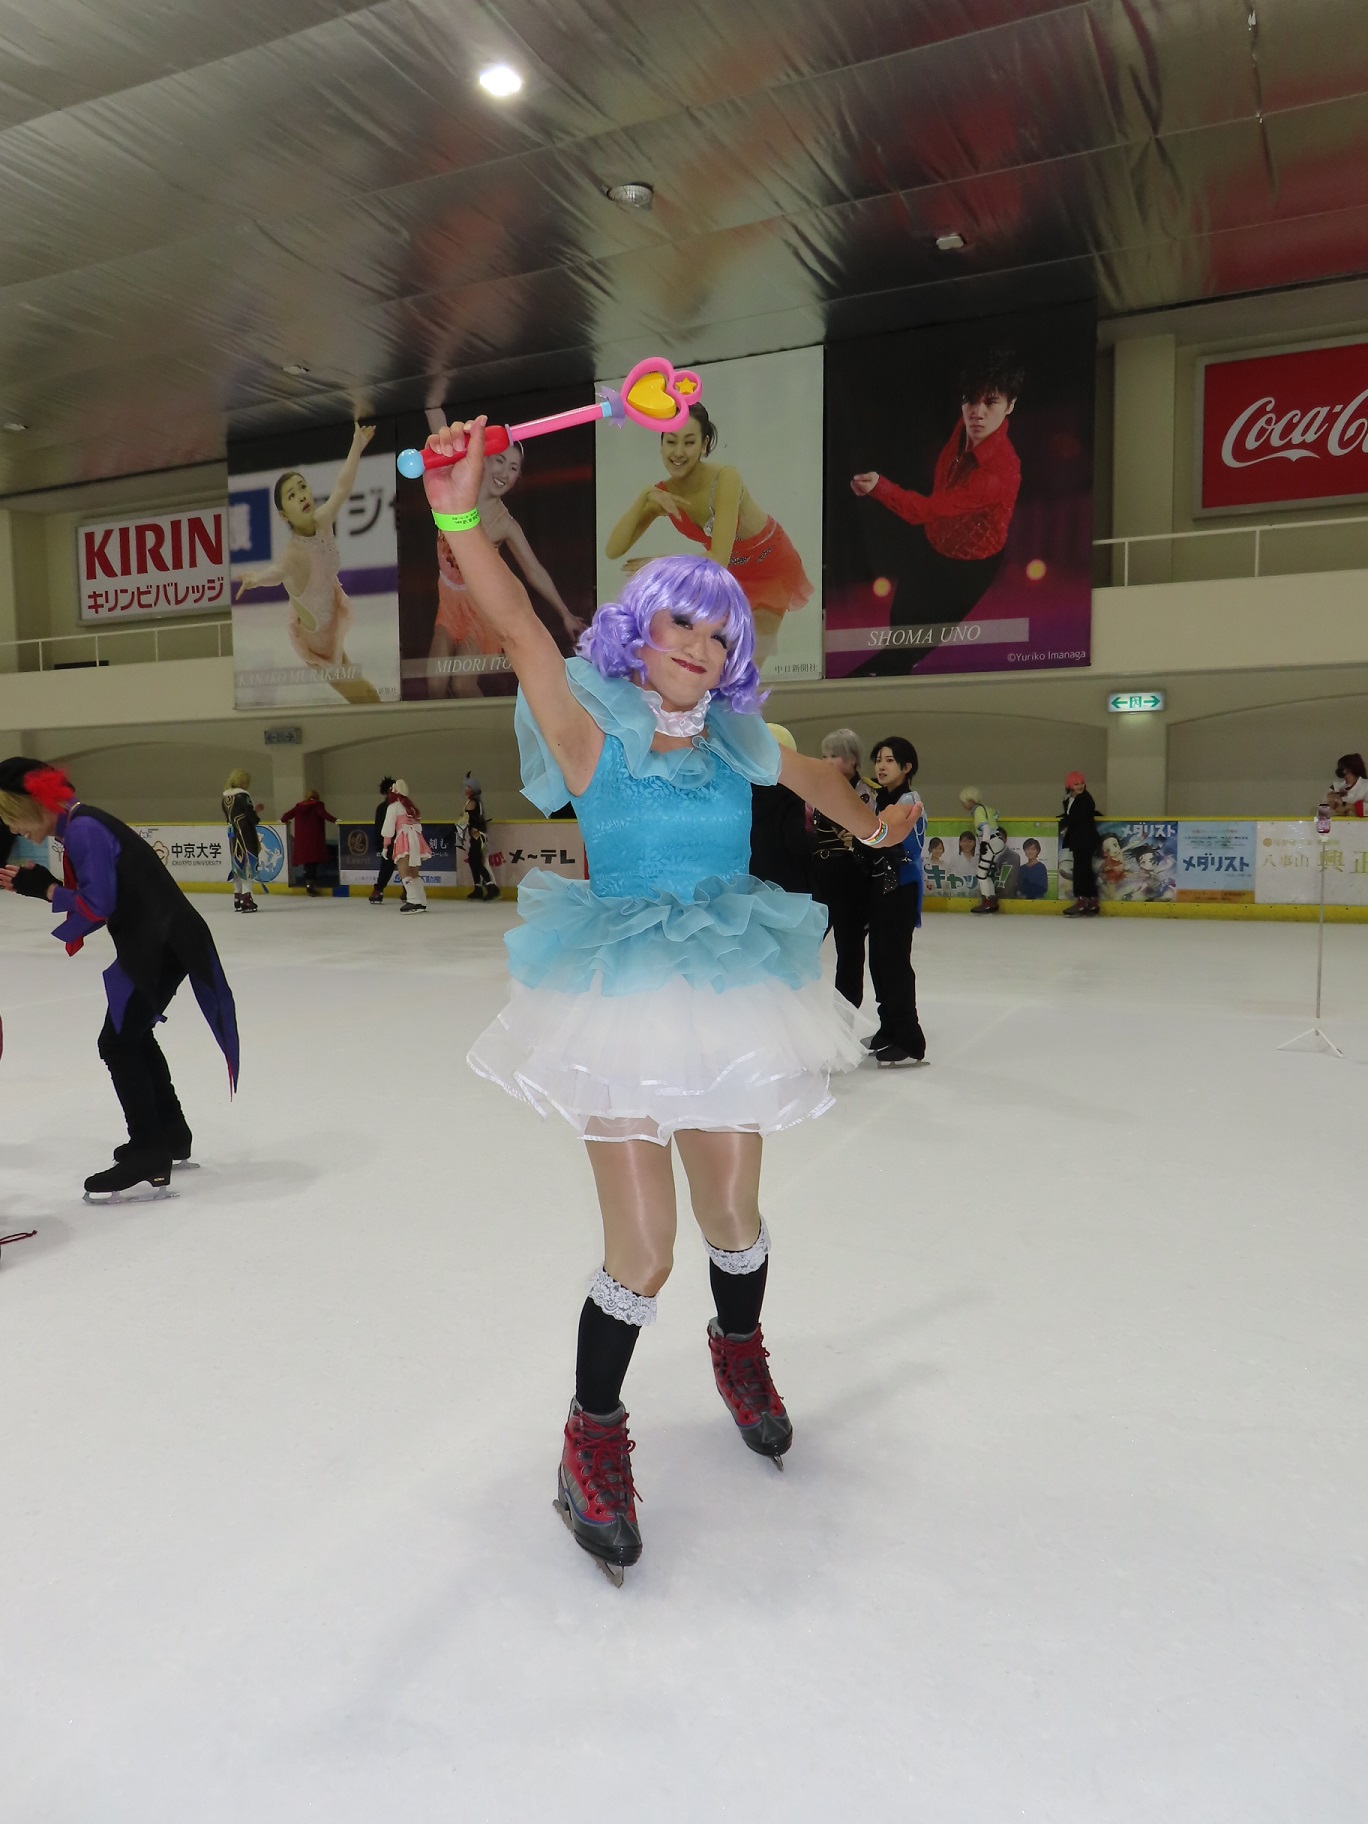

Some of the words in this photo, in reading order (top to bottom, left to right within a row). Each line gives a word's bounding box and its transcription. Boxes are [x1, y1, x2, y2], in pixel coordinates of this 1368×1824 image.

[1222, 388, 1368, 468] Coca-C
[84, 514, 223, 580] KIRIN
[87, 577, 224, 614] キリンビバレッジ
[868, 628, 933, 647] SHOMA
[940, 625, 981, 643] UNO
[436, 658, 487, 673] MIDORI
[490, 656, 512, 670] ITO
[1048, 650, 1086, 661] Imanaga
[239, 670, 286, 686] KANAKO
[290, 667, 357, 683] MURAKAMI
[1121, 822, 1176, 839] メダリスト
[171, 843, 222, 858] 中京大学
[1183, 853, 1249, 872] メダリスト
